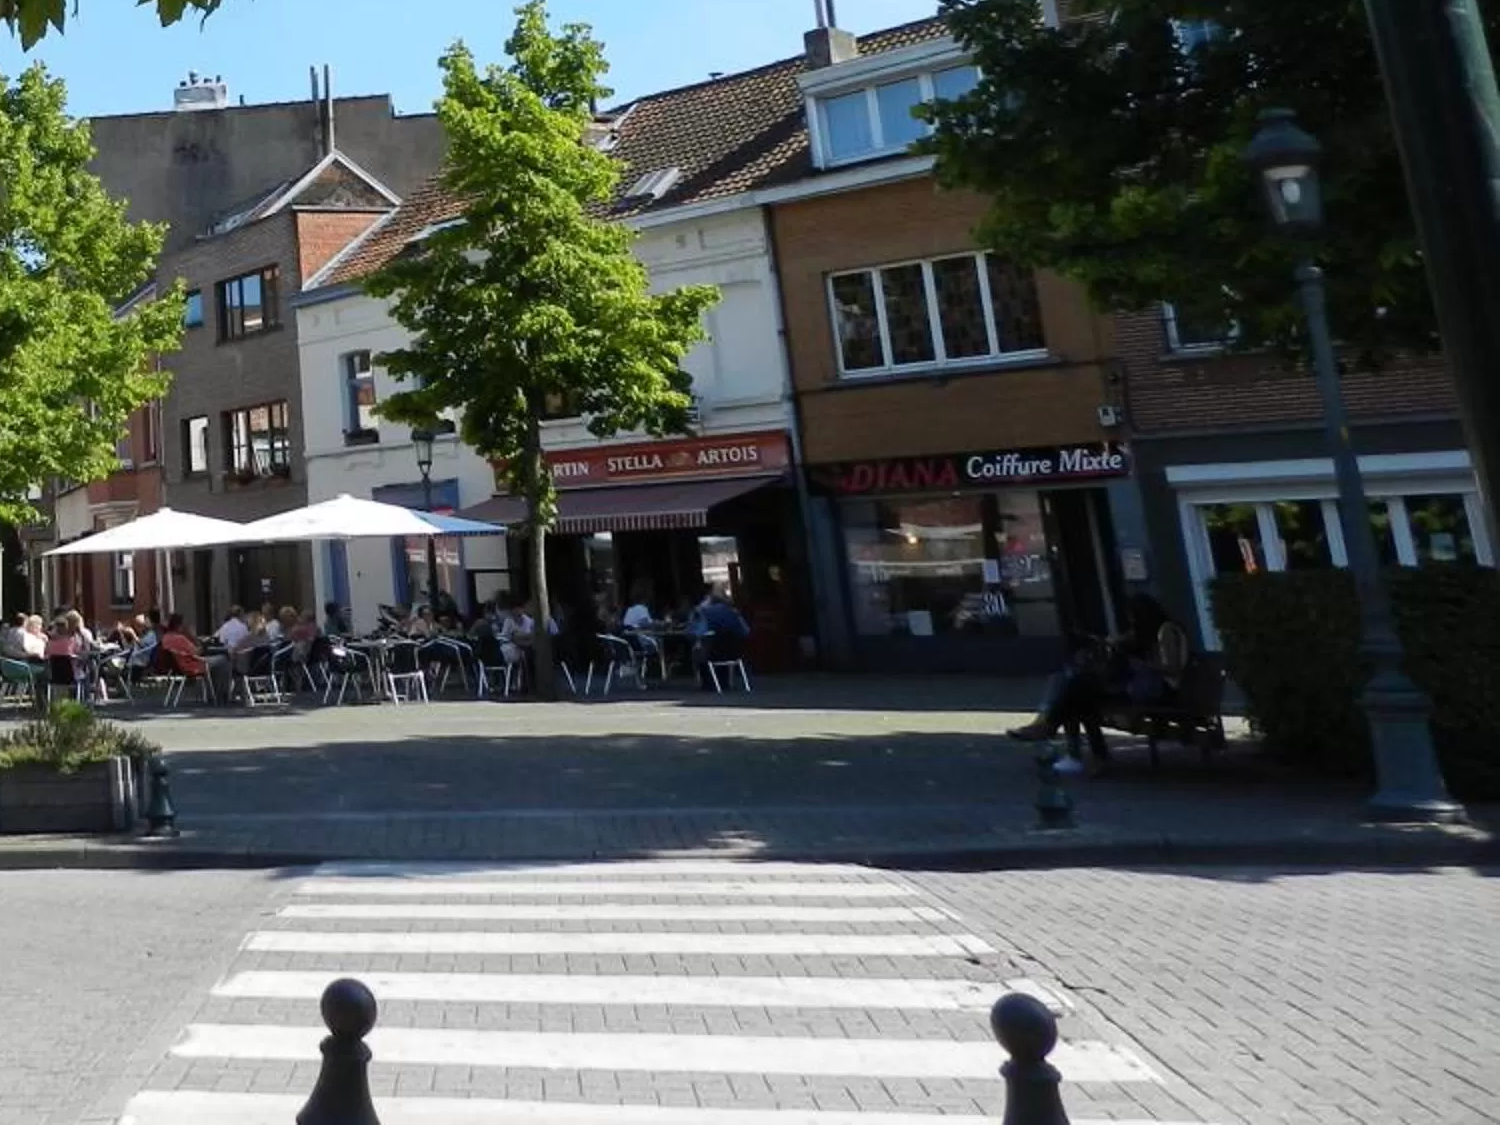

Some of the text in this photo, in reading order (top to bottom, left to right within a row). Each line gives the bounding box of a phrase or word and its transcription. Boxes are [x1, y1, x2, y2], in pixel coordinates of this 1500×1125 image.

[552, 445, 758, 477] RTIN STELLA ARTOIS
[838, 448, 1123, 491] DIANA Coiffure Mixte
